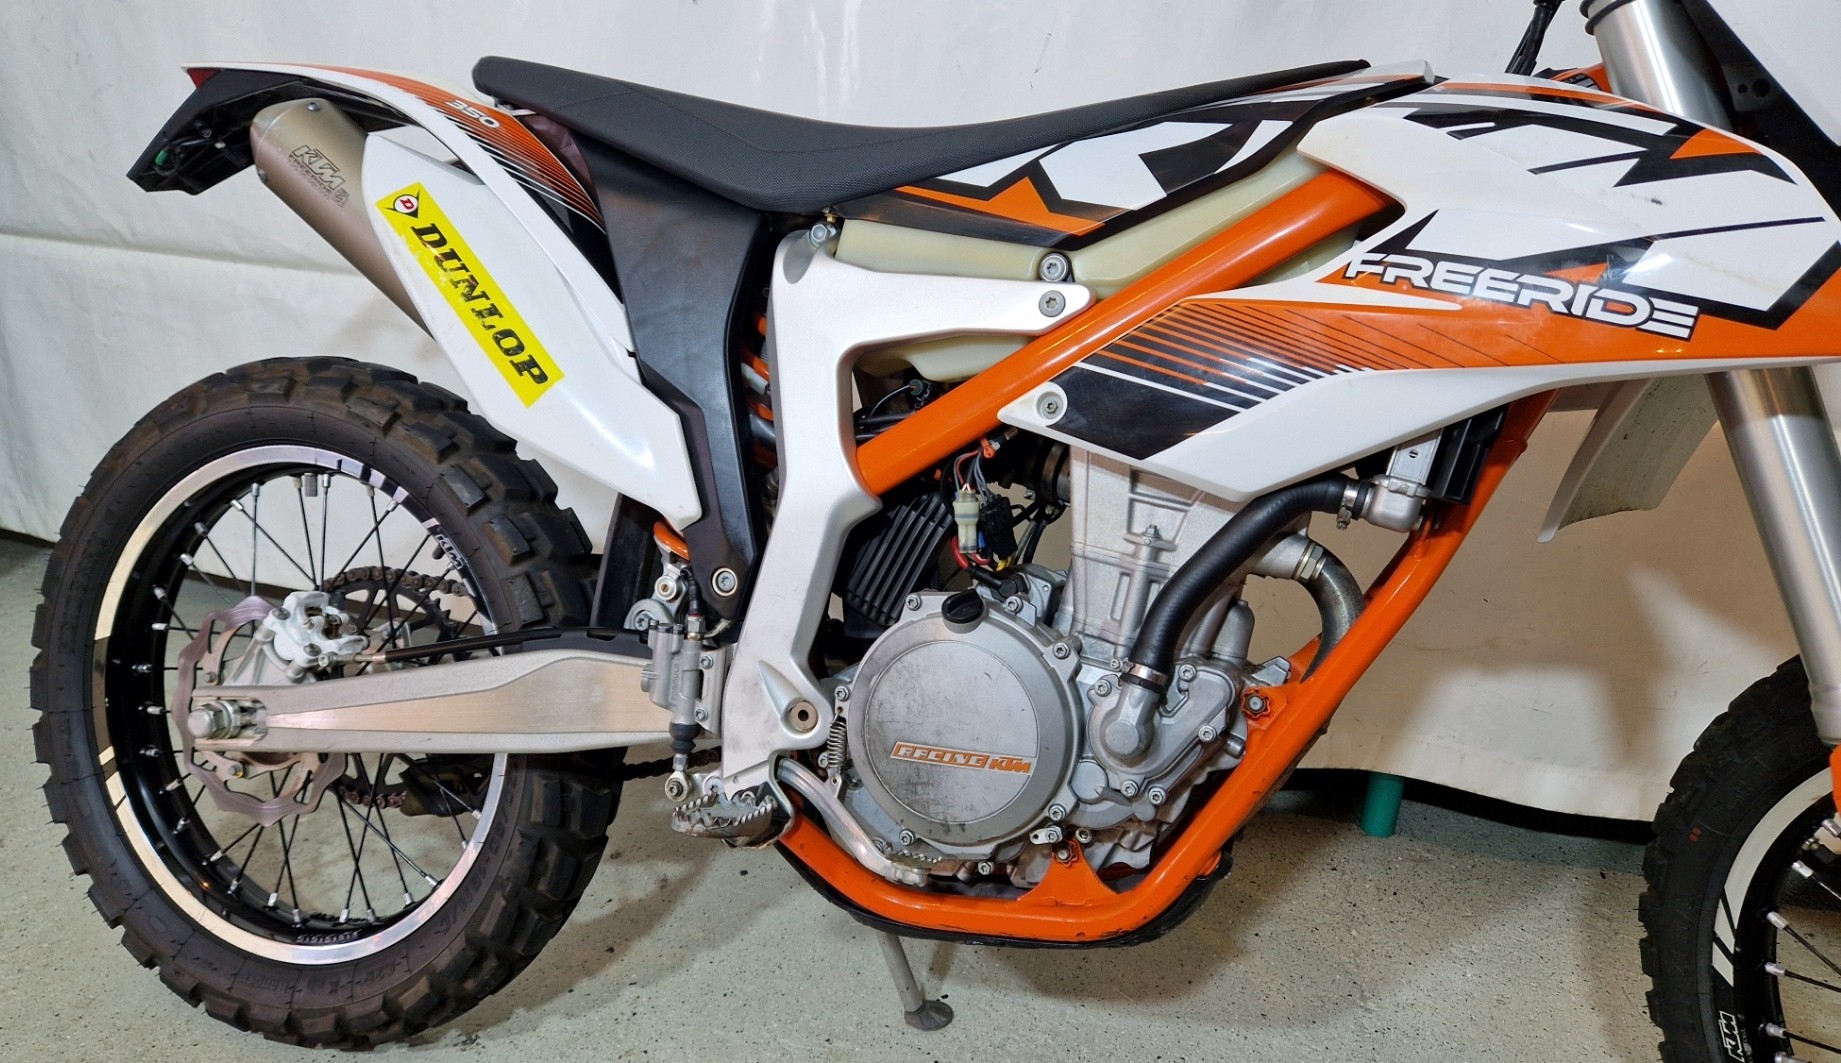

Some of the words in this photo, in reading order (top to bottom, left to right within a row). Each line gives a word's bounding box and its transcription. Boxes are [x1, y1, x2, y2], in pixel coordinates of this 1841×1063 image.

[444, 99, 500, 128] 350
[291, 145, 346, 191] KTM
[399, 197, 415, 210] D
[411, 222, 549, 385] DUNLOP
[1343, 251, 1700, 341] FREERIDE
[434, 533, 464, 570] KTM
[988, 757, 1032, 774] KTM
[1718, 1010, 1746, 1063] KTM
